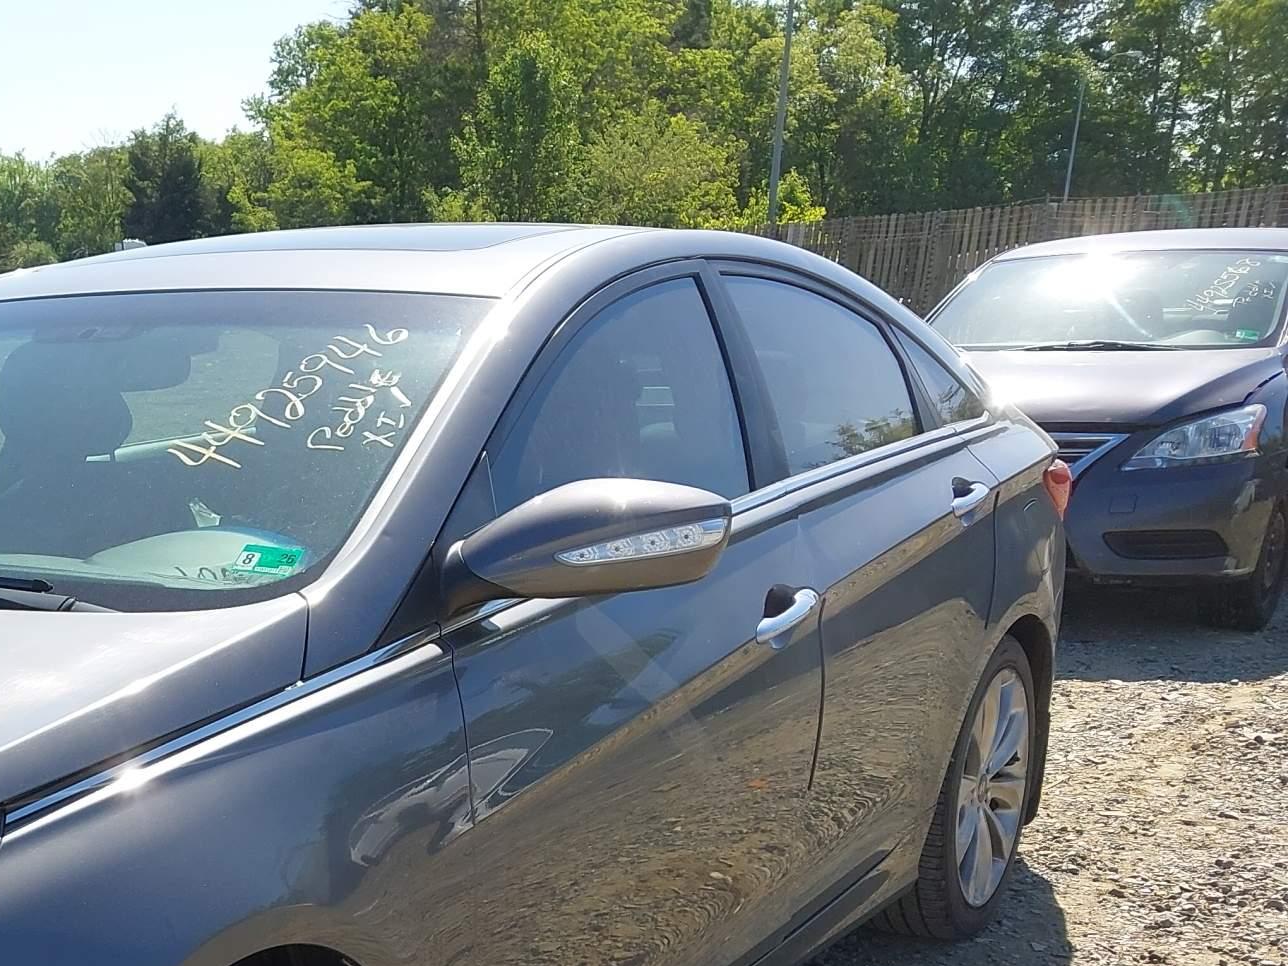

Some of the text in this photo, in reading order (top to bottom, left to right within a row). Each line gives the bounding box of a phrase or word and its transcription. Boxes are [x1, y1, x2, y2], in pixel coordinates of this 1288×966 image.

[167, 323, 409, 469] 44925946
[242, 553, 296, 565] 8 26
